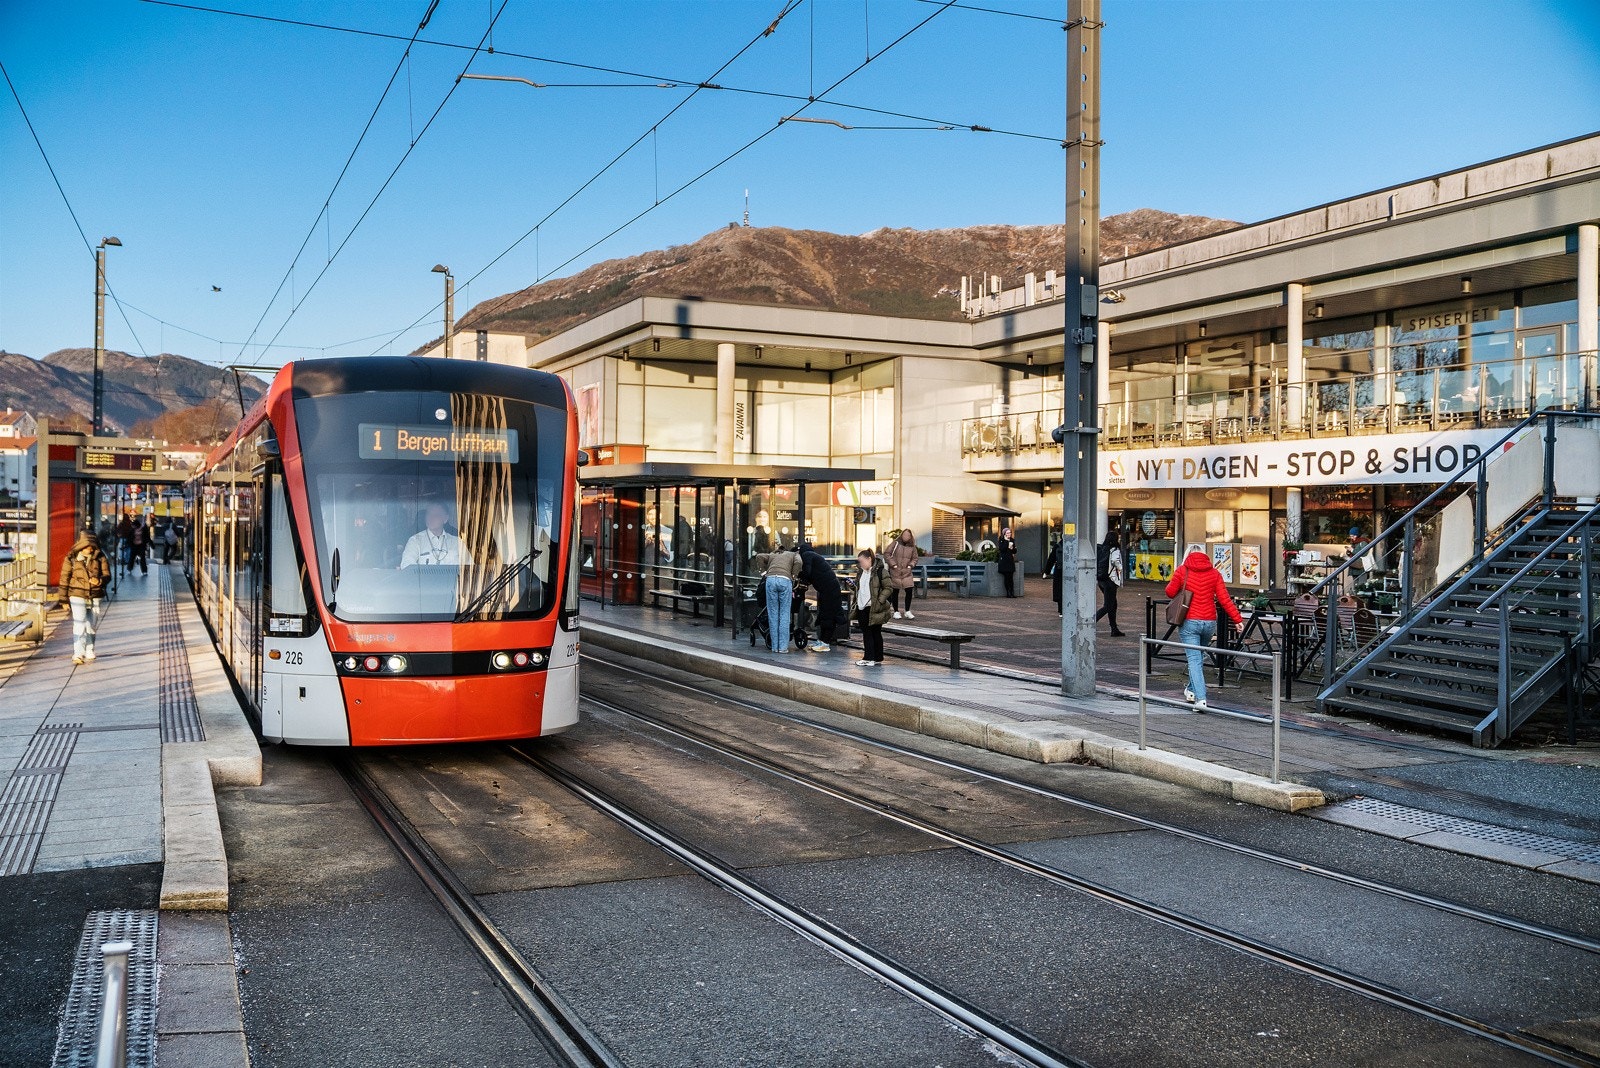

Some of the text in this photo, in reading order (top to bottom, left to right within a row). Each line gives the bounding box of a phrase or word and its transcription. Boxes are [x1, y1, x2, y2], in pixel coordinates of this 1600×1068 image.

[1410, 308, 1489, 331] SPISERIET
[736, 402, 744, 440] ZAVANNA
[374, 430, 382, 451] 1
[398, 430, 448, 456] Bergen
[1137, 459, 1176, 480] NYT
[1182, 455, 1258, 480] DAGEN
[1286, 450, 1355, 476] STOP
[1365, 448, 1382, 474] &
[1392, 444, 1481, 474] SHOP
[286, 651, 303, 665] 226
